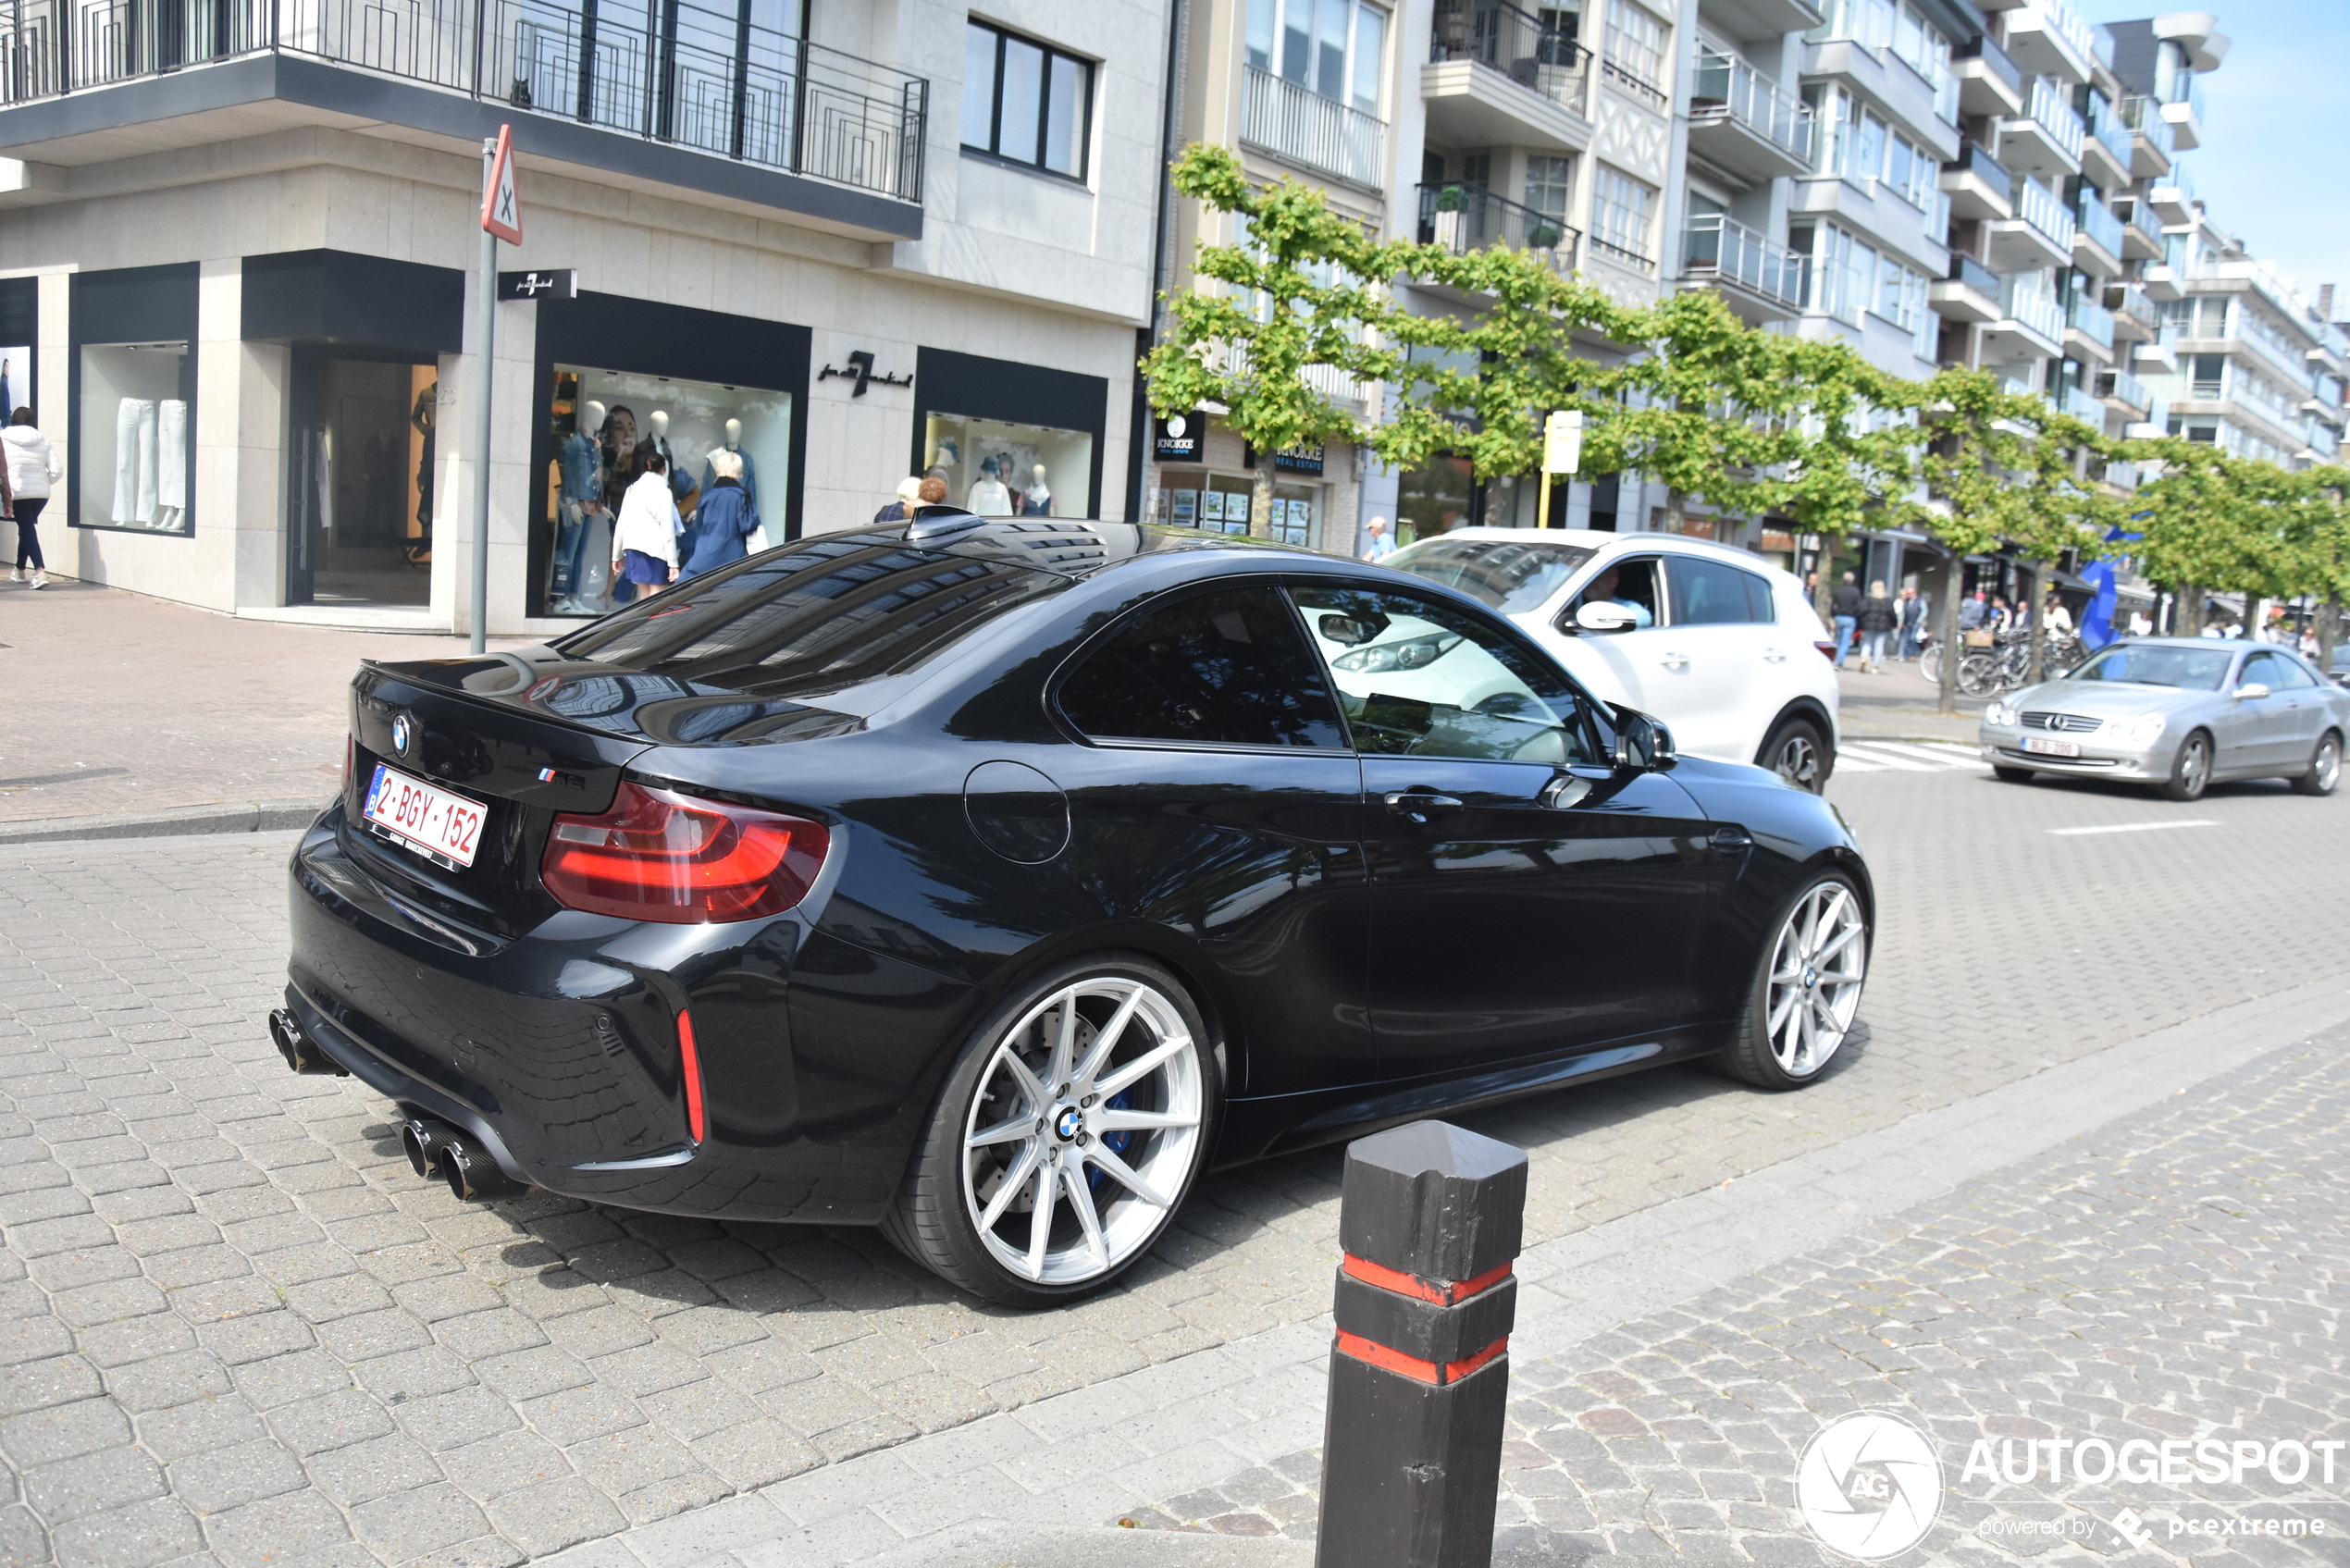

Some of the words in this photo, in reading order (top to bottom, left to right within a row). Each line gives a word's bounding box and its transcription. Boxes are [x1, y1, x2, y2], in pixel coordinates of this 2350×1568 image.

[1156, 438, 1194, 450] KNOKKE
[1277, 456, 1294, 467] REAL
[1296, 459, 1321, 471] ESTATE
